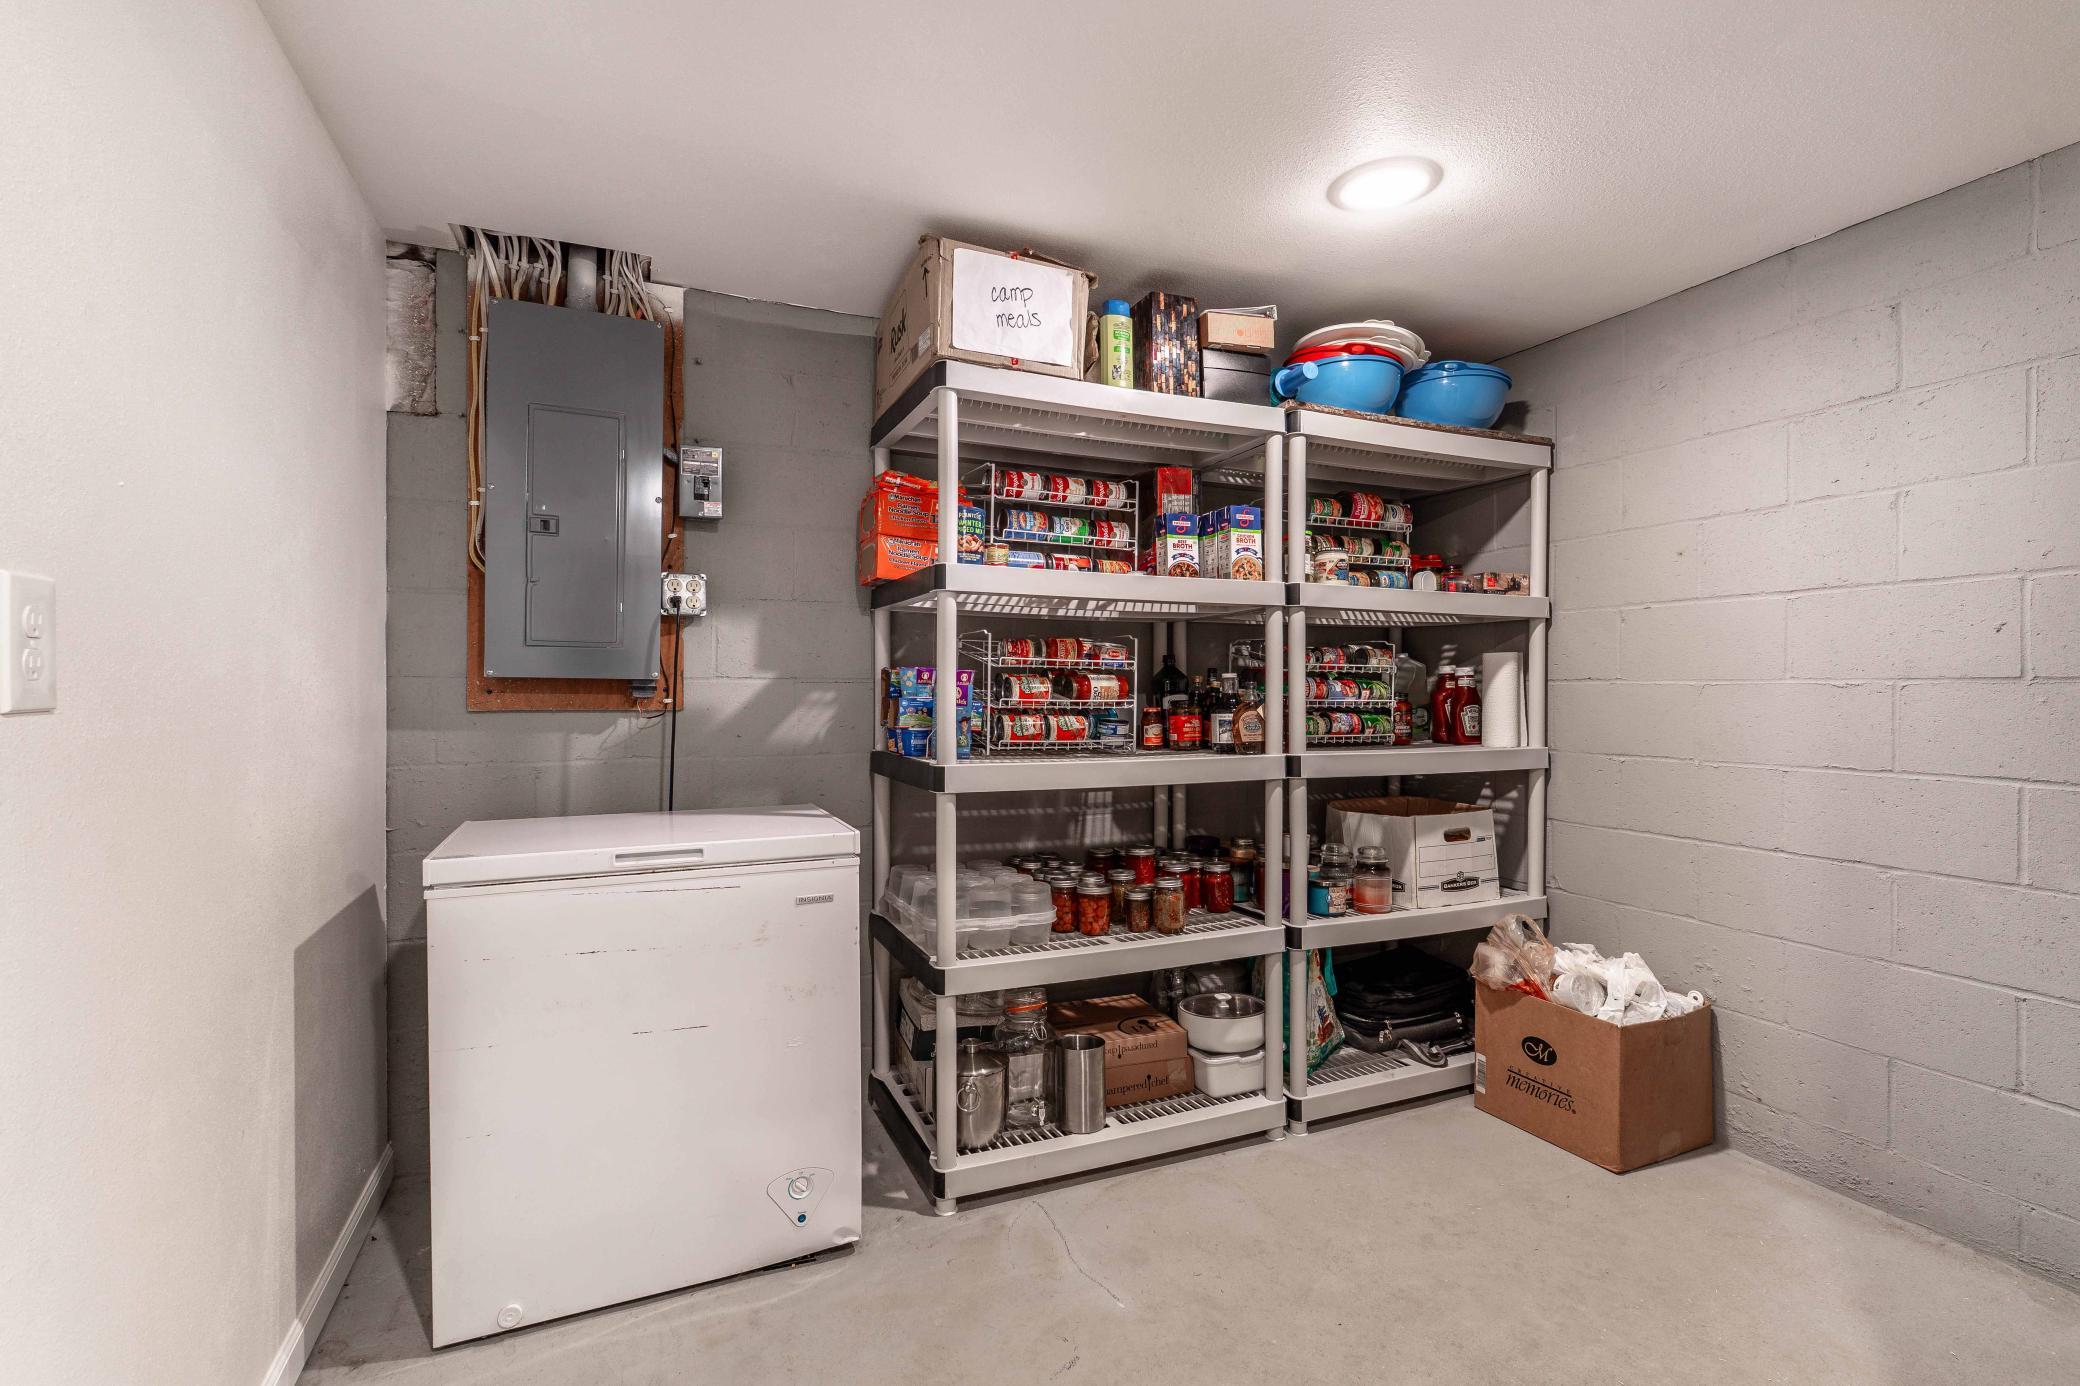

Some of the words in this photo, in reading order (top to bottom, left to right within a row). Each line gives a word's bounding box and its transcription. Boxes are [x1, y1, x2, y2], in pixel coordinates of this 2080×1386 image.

[991, 286, 1034, 308] camp
[995, 309, 1042, 328] meals
[1443, 881, 1467, 889] BANKERS
[798, 895, 833, 903] INSIGNIA
[1105, 1079, 1147, 1096] ampered
[1151, 1075, 1169, 1087] chef
